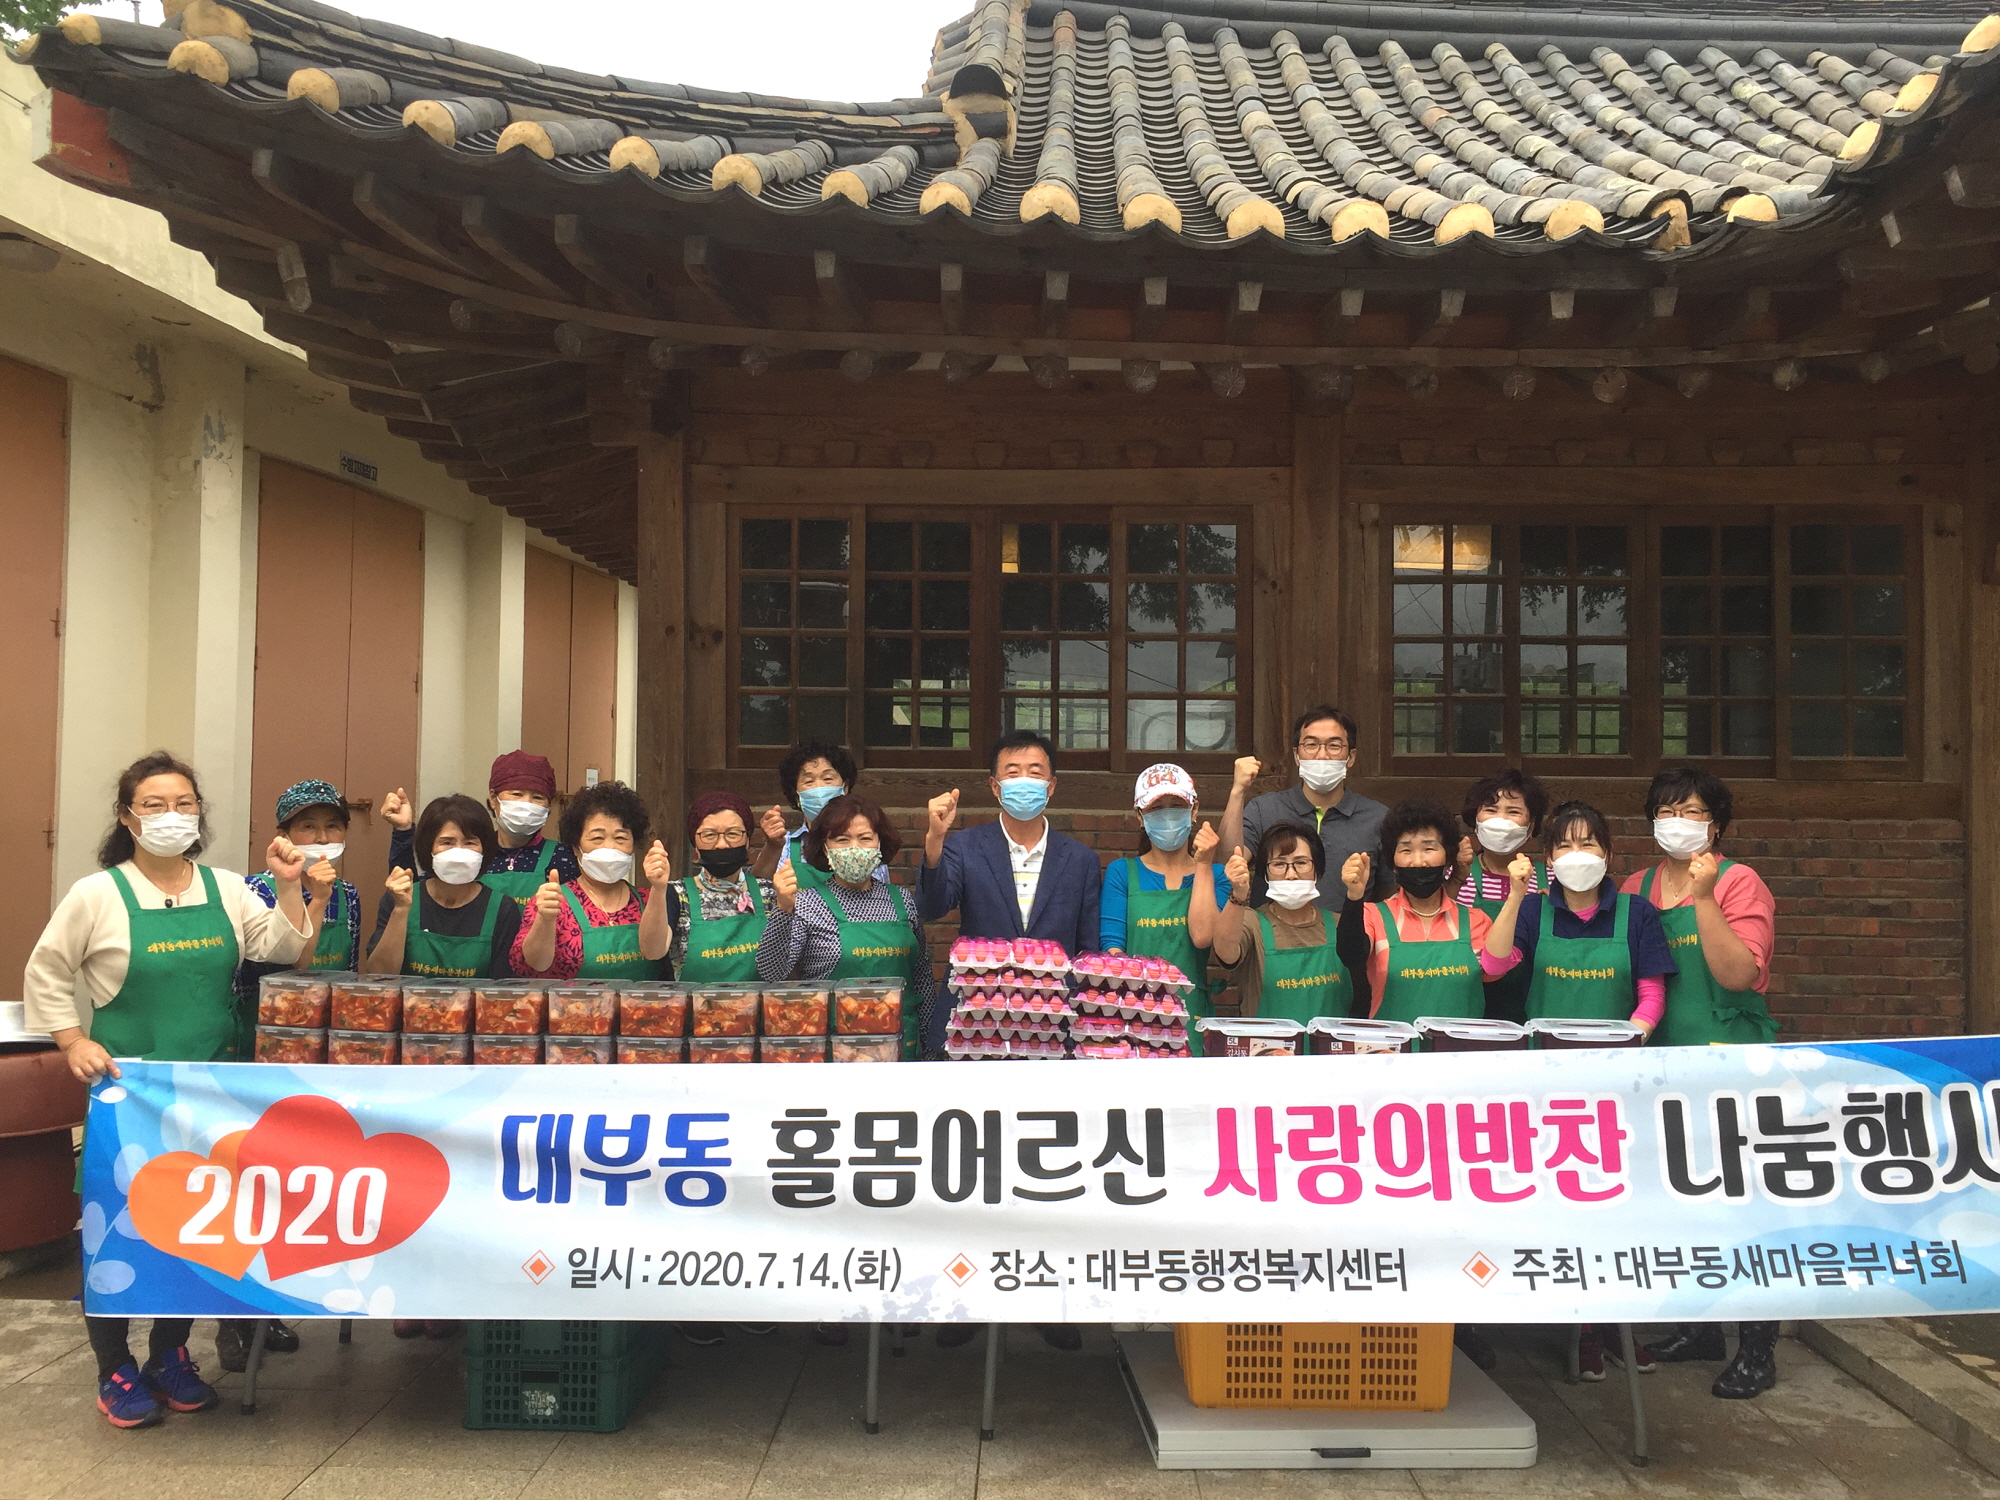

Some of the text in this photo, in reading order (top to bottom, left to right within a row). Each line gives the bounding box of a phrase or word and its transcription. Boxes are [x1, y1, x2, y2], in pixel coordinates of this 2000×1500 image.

[1227, 1037, 1238, 1045] 5L
[1332, 1042, 1342, 1050] 5L
[500, 1111, 732, 1208] 대부동
[766, 1107, 1168, 1209] 홀몸어르신
[1204, 1100, 1627, 1206] 사랑의반찬
[178, 1165, 388, 1245] 2020
